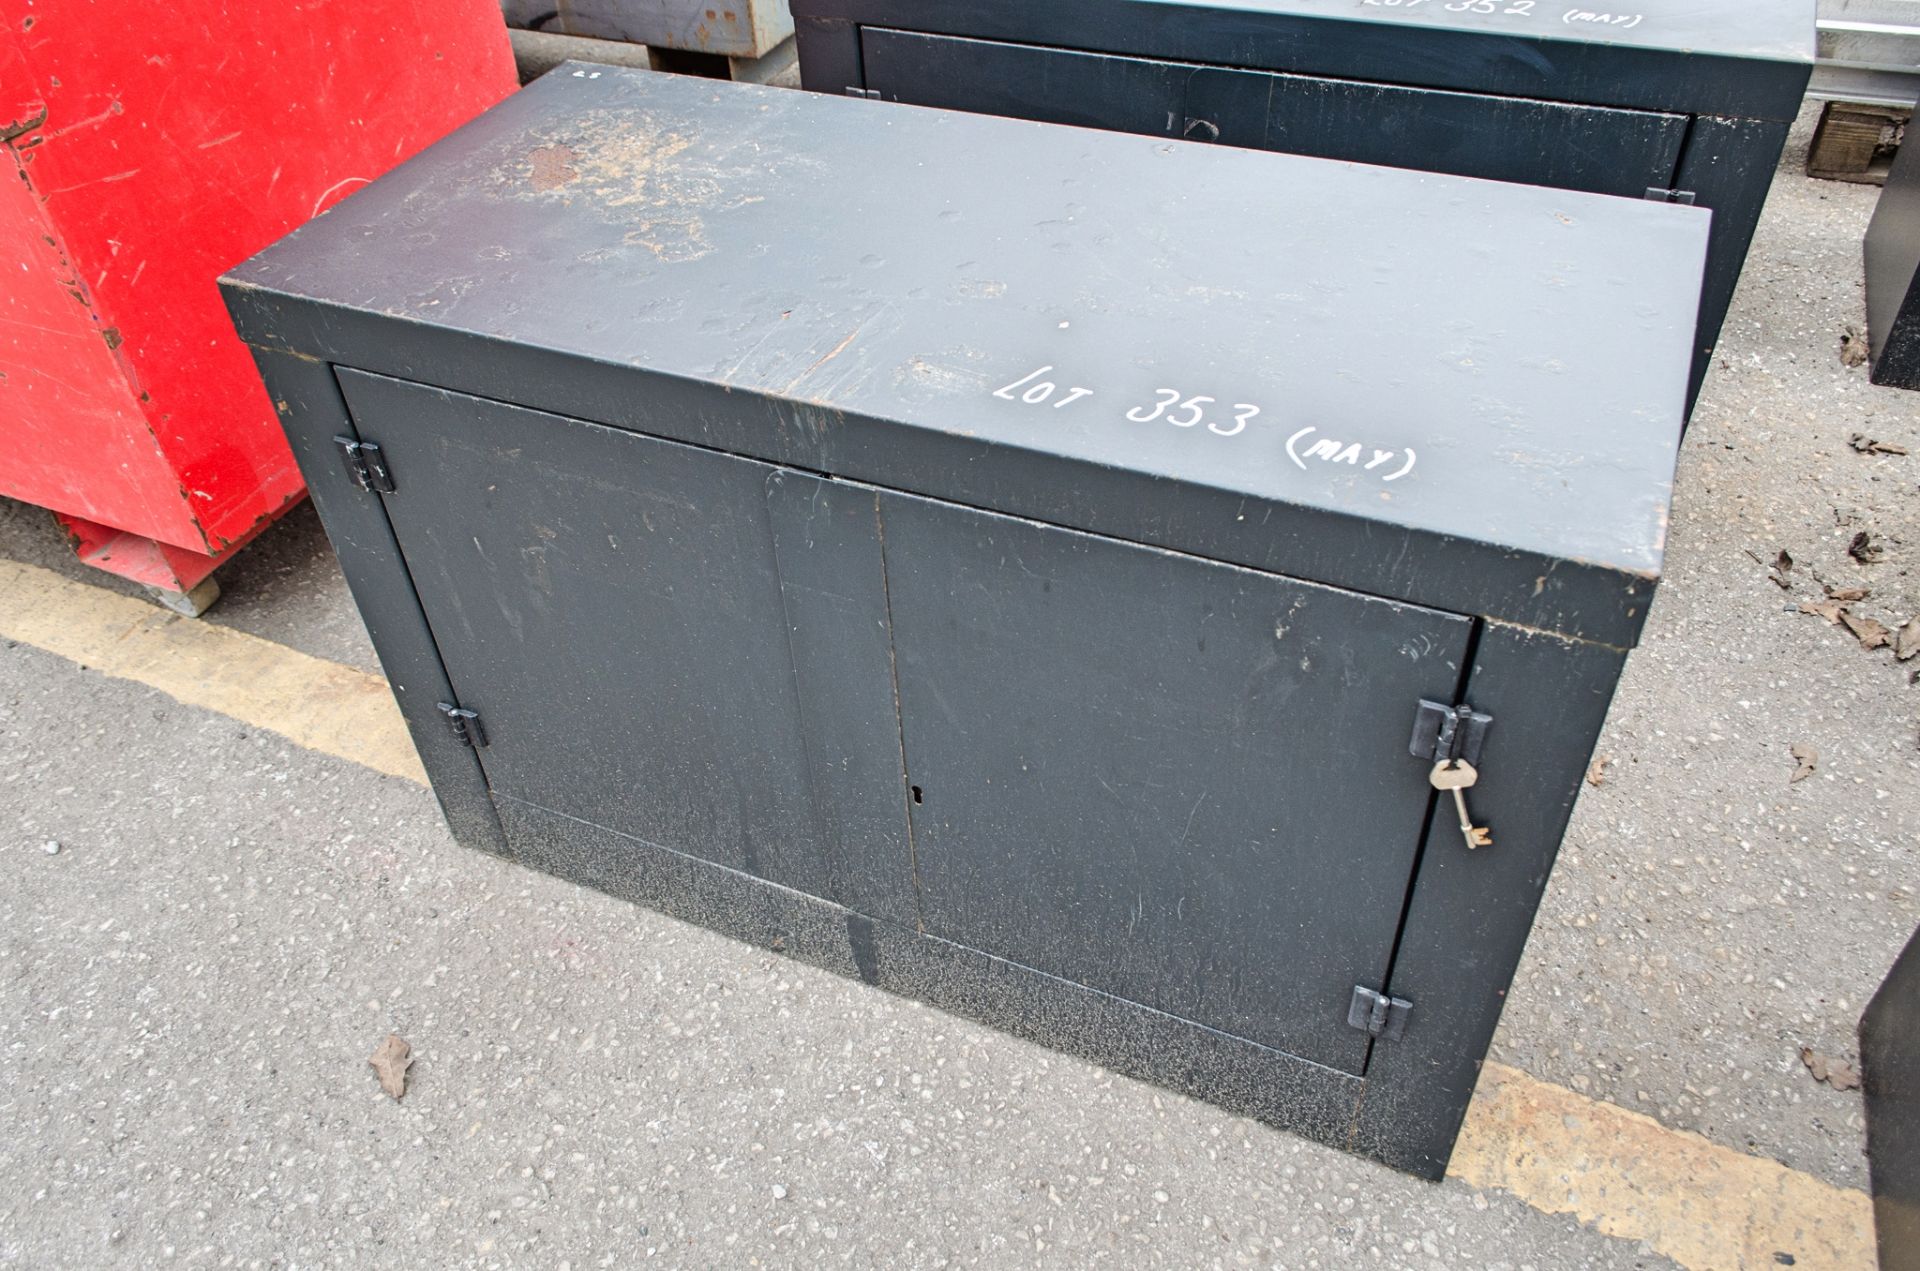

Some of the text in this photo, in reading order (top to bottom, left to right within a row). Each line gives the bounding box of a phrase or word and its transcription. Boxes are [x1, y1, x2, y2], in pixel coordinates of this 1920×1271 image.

[1443, 0, 1536, 17] 352
[992, 365, 1417, 481] LOT 353 (MAY)
